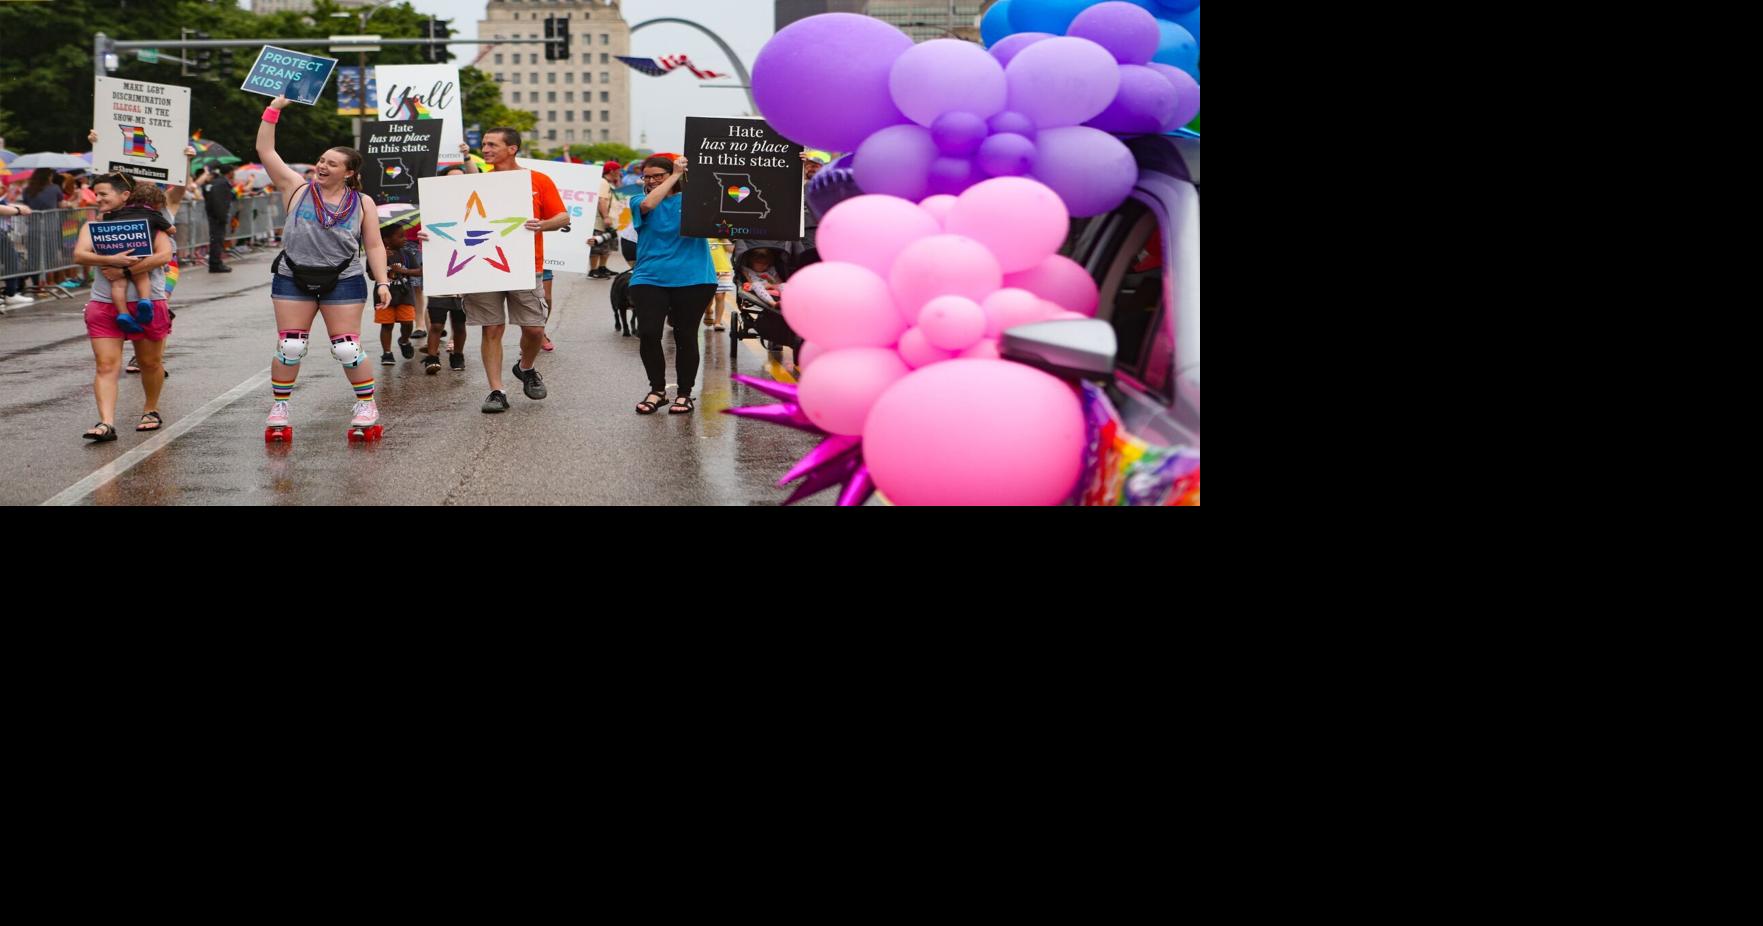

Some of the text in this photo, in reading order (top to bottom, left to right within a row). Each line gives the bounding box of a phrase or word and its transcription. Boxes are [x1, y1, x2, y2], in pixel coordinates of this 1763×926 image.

[263, 52, 323, 72] PROTECT
[259, 64, 302, 81] TRANS
[123, 82, 165, 95] MAKE LGBT
[250, 75, 283, 90] KIDS
[112, 91, 172, 106] DISCRIMINATION
[385, 80, 454, 119] Y'all
[112, 102, 170, 117] ILLEGAL IN THE
[113, 113, 173, 128] SHOW-ME STATE.
[389, 124, 413, 133] Hate
[728, 125, 764, 138] Hate
[369, 134, 387, 143] has
[403, 133, 430, 144] place
[700, 138, 789, 154] has no place
[368, 144, 430, 154] in this state.
[698, 153, 789, 168] in this state.
[97, 223, 145, 233] SUPPORT
[93, 232, 147, 242] MISSOURI
